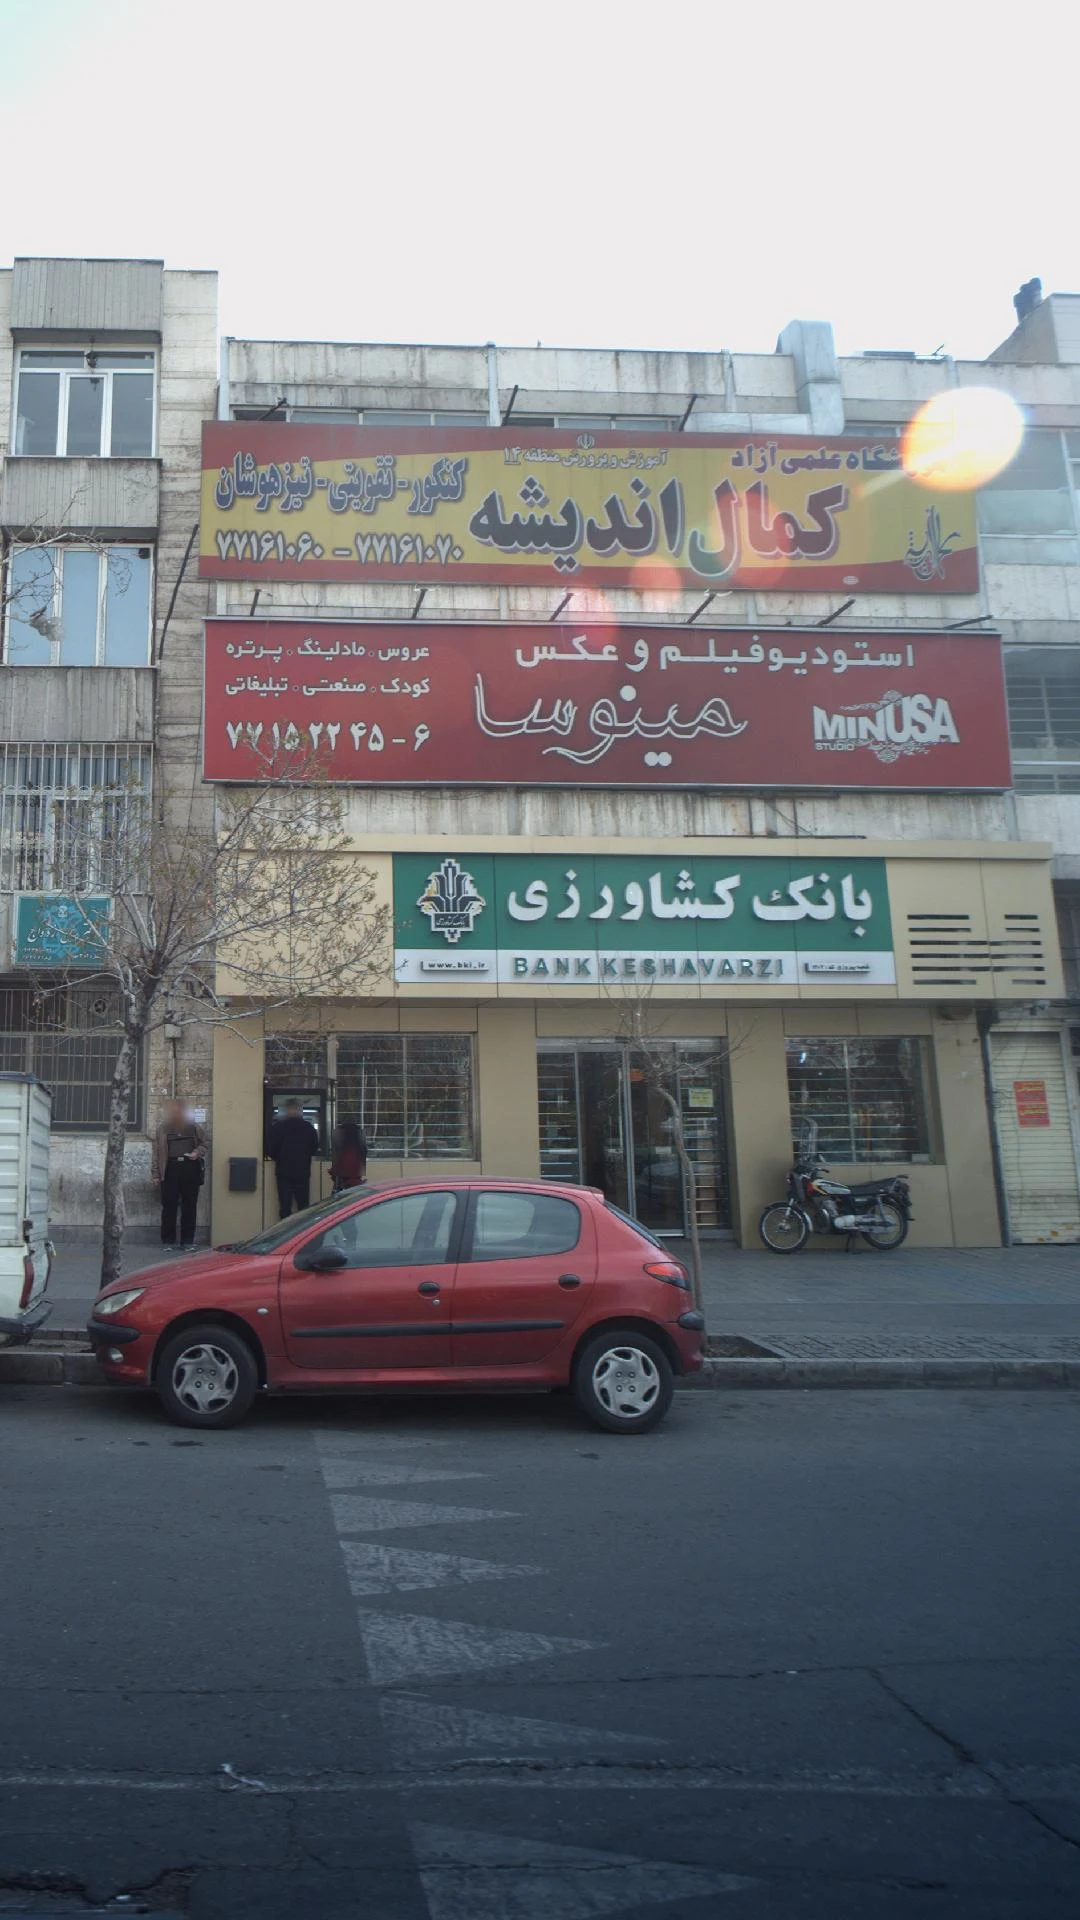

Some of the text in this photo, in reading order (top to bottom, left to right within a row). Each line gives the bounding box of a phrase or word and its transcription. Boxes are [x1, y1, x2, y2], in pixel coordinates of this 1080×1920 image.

[503, 446, 522, 465] ۱۴
[523, 447, 561, 463] منطقه
[620, 448, 668, 468] آموزش
[731, 440, 778, 474] آزاد
[780, 445, 842, 475] علمی
[468, 475, 686, 574] اندیشه
[688, 476, 848, 577] کمال
[215, 530, 325, 563] ۷۷۱۶۱۰۶۰
[354, 532, 464, 566] ۷۷۱۶۱۰۷۰
[225, 637, 430, 664] عروس مادلینگ پرتره
[516, 634, 619, 668] عکس
[625, 638, 650, 672] و
[225, 675, 431, 699] کودک صنعتی تبلیغاتی
[815, 742, 856, 752] STUDIO
[507, 867, 874, 938] بانک کشاورزی
[512, 957, 784, 978] BANK KESHAVARZI
